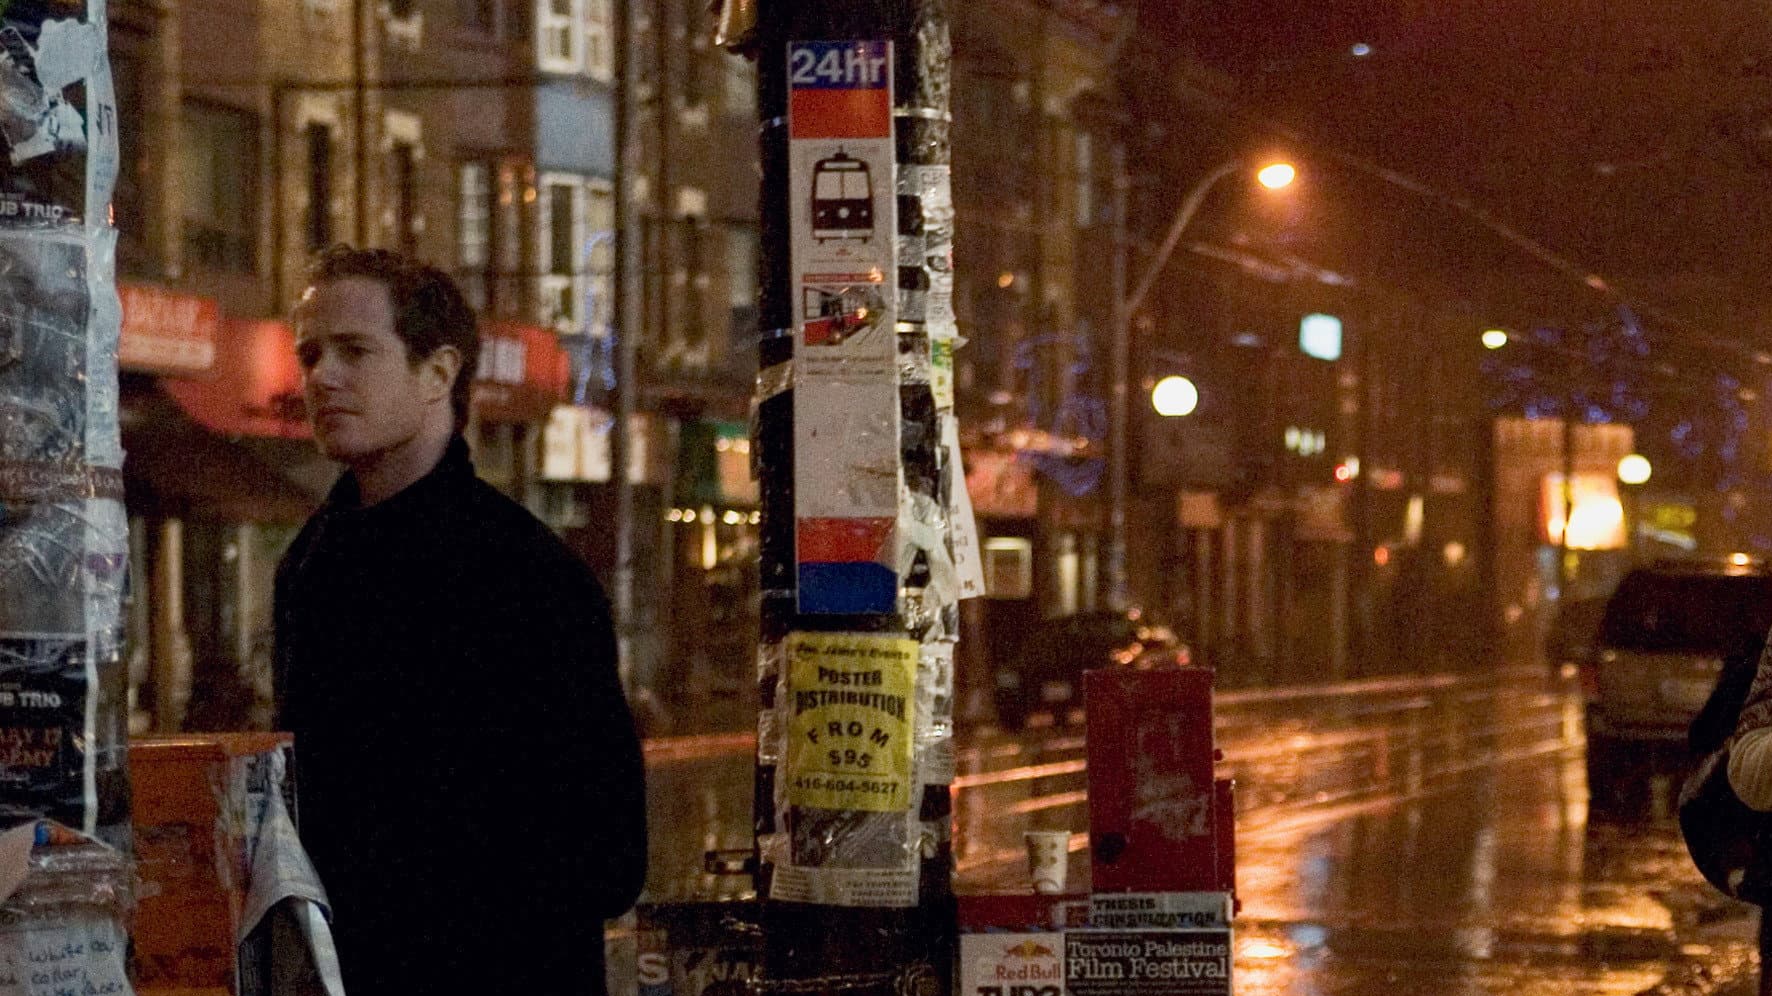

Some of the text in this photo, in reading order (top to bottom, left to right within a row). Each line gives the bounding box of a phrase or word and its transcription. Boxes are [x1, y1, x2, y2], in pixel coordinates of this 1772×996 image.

[791, 47, 886, 84] 24hr
[818, 666, 883, 687] POSTER
[18, 691, 61, 708] TRIO
[796, 690, 906, 722] DISTRIBUTION
[806, 721, 890, 748] FROM
[1093, 898, 1156, 911] THESIS
[1093, 912, 1217, 928] CONSULTATION
[1067, 940, 1228, 958] Toronto Palestine
[1067, 957, 1227, 979] Film Festival
